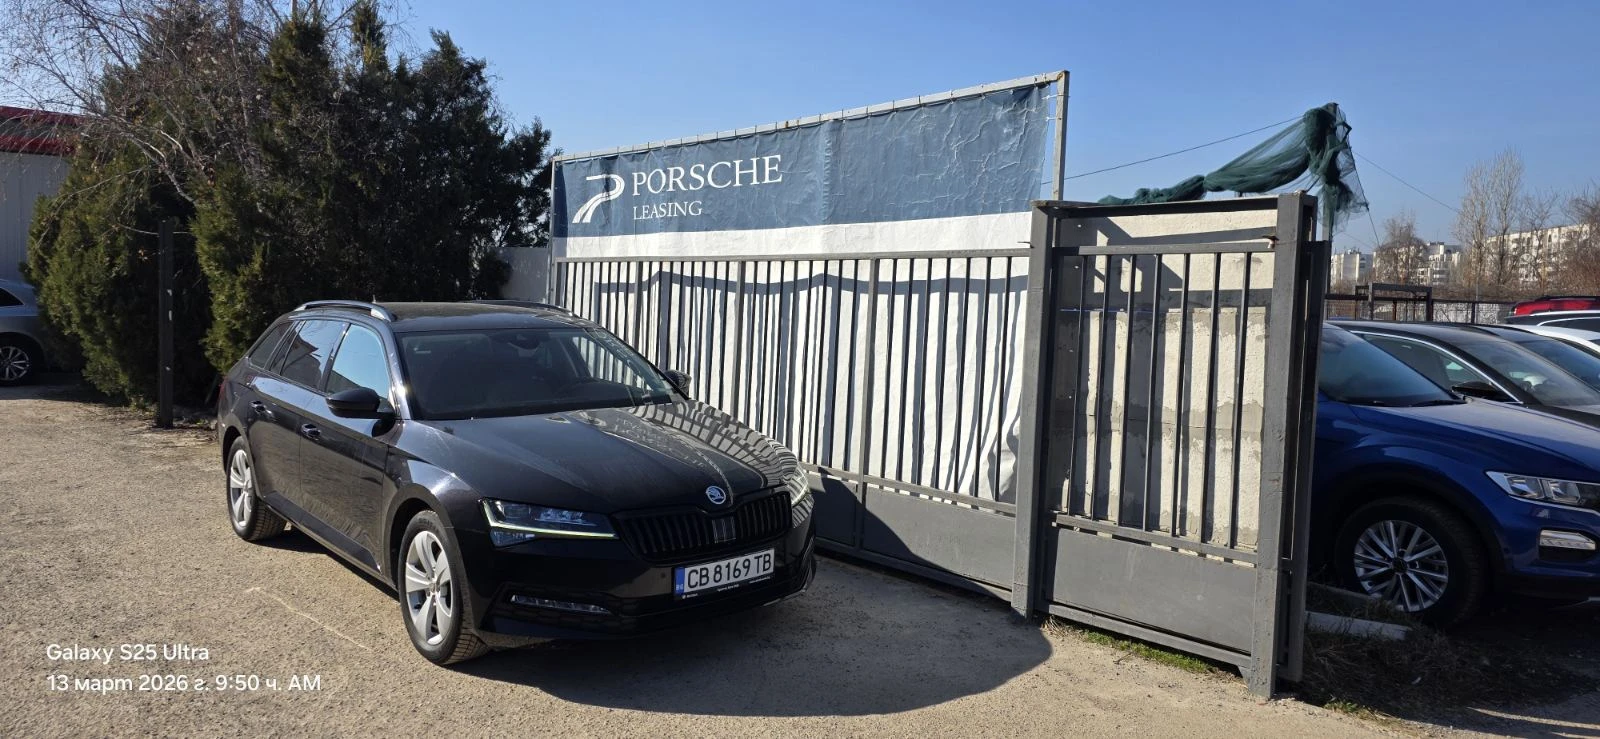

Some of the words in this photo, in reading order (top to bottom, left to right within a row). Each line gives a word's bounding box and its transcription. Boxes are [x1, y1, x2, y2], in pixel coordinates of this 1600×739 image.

[632, 154, 783, 196] PORSCHE
[633, 201, 703, 220] LEASING
[687, 567, 709, 589] CB
[713, 558, 751, 583] 8169
[754, 553, 772, 574] TB
